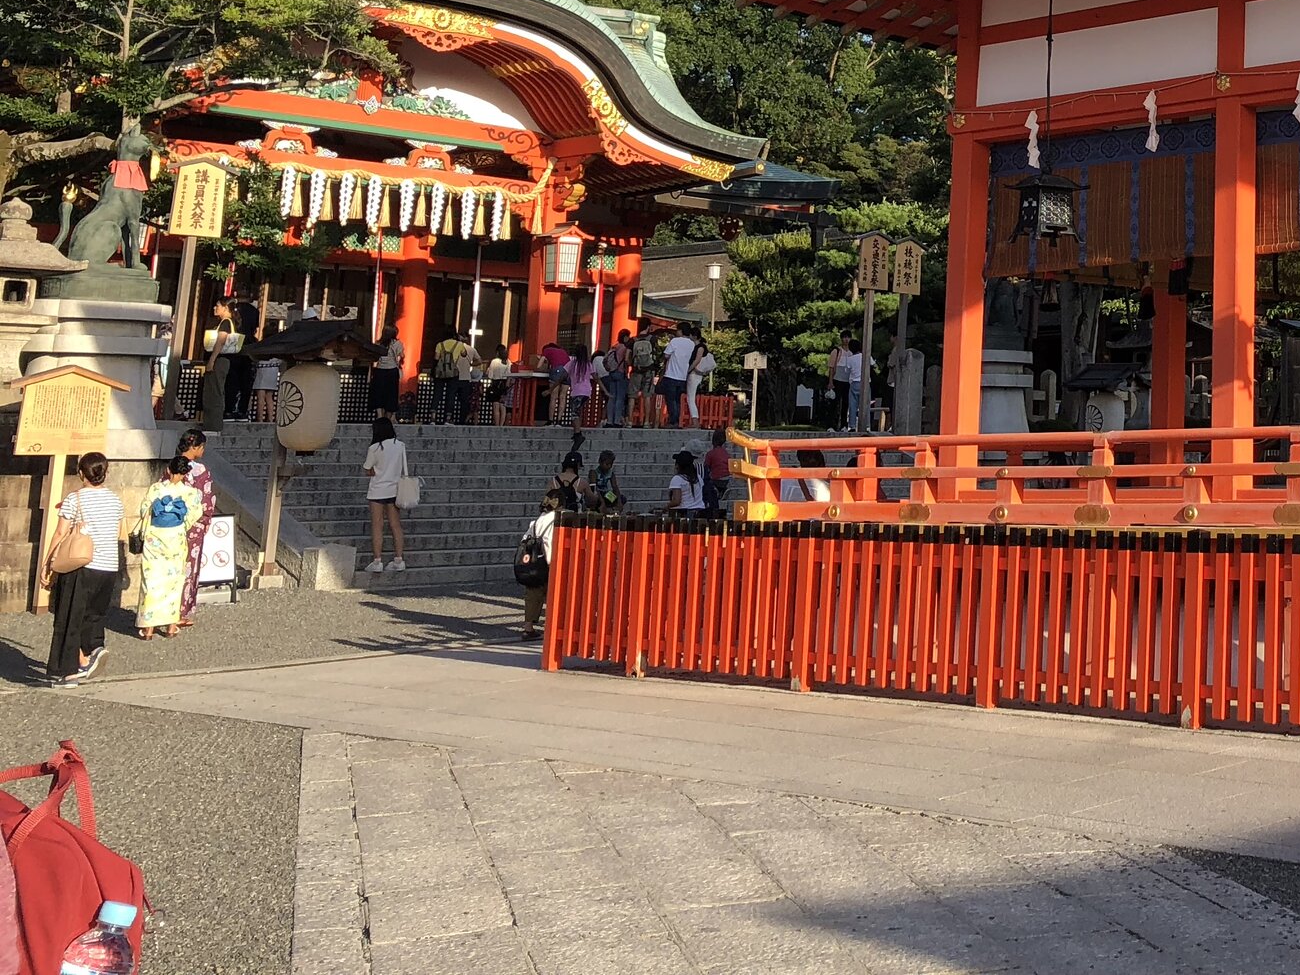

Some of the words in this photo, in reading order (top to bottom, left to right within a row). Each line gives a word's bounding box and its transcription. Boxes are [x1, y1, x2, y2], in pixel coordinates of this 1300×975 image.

[190, 168, 211, 230] 講員大祭
[869, 238, 880, 288] 交通安全祭
